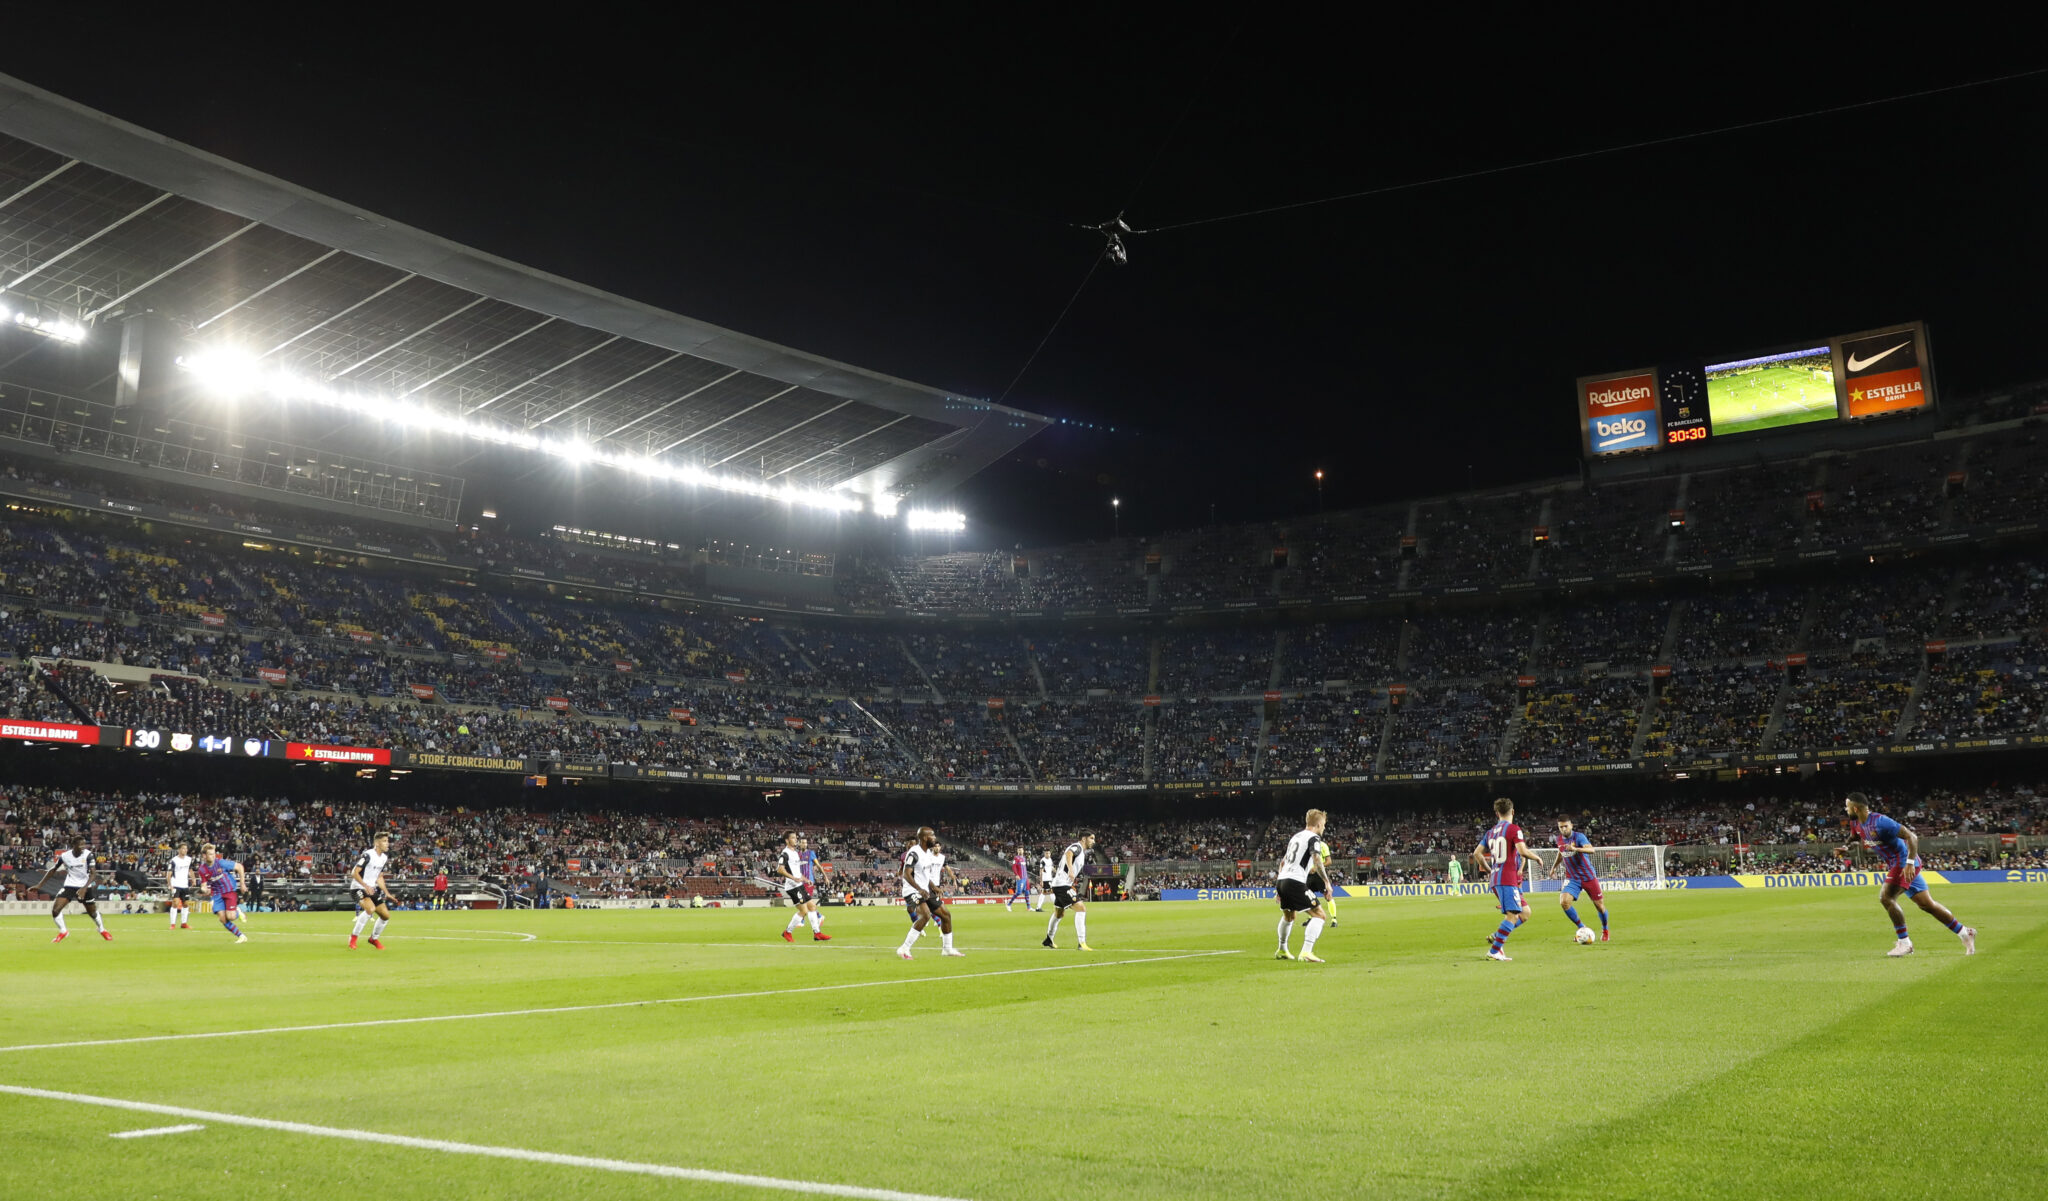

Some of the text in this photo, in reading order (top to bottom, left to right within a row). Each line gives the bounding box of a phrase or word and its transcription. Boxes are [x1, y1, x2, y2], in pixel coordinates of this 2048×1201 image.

[1589, 387, 1650, 405] Rakuten
[1866, 381, 1922, 400] ESTRELLA
[1885, 394, 1905, 402] DAMM
[1597, 418, 1646, 437] beko
[1674, 418, 1703, 427] BARCELONA
[1668, 427, 1706, 443] 30:30
[2, 725, 78, 740] ESTRELLA DAMM
[135, 729, 160, 748] 30
[204, 735, 232, 754] 1-1
[1903, 745, 1914, 753] QUE
[314, 750, 374, 762] ESTRELLA DAMM
[419, 753, 523, 770] STORE.FCBARCELONA.COM
[657, 770, 666, 778] QUE
[1764, 873, 1868, 888] DOWNLOAD
[797, 891, 803, 899] 6
[1369, 884, 1453, 896] DOWNLOAD
